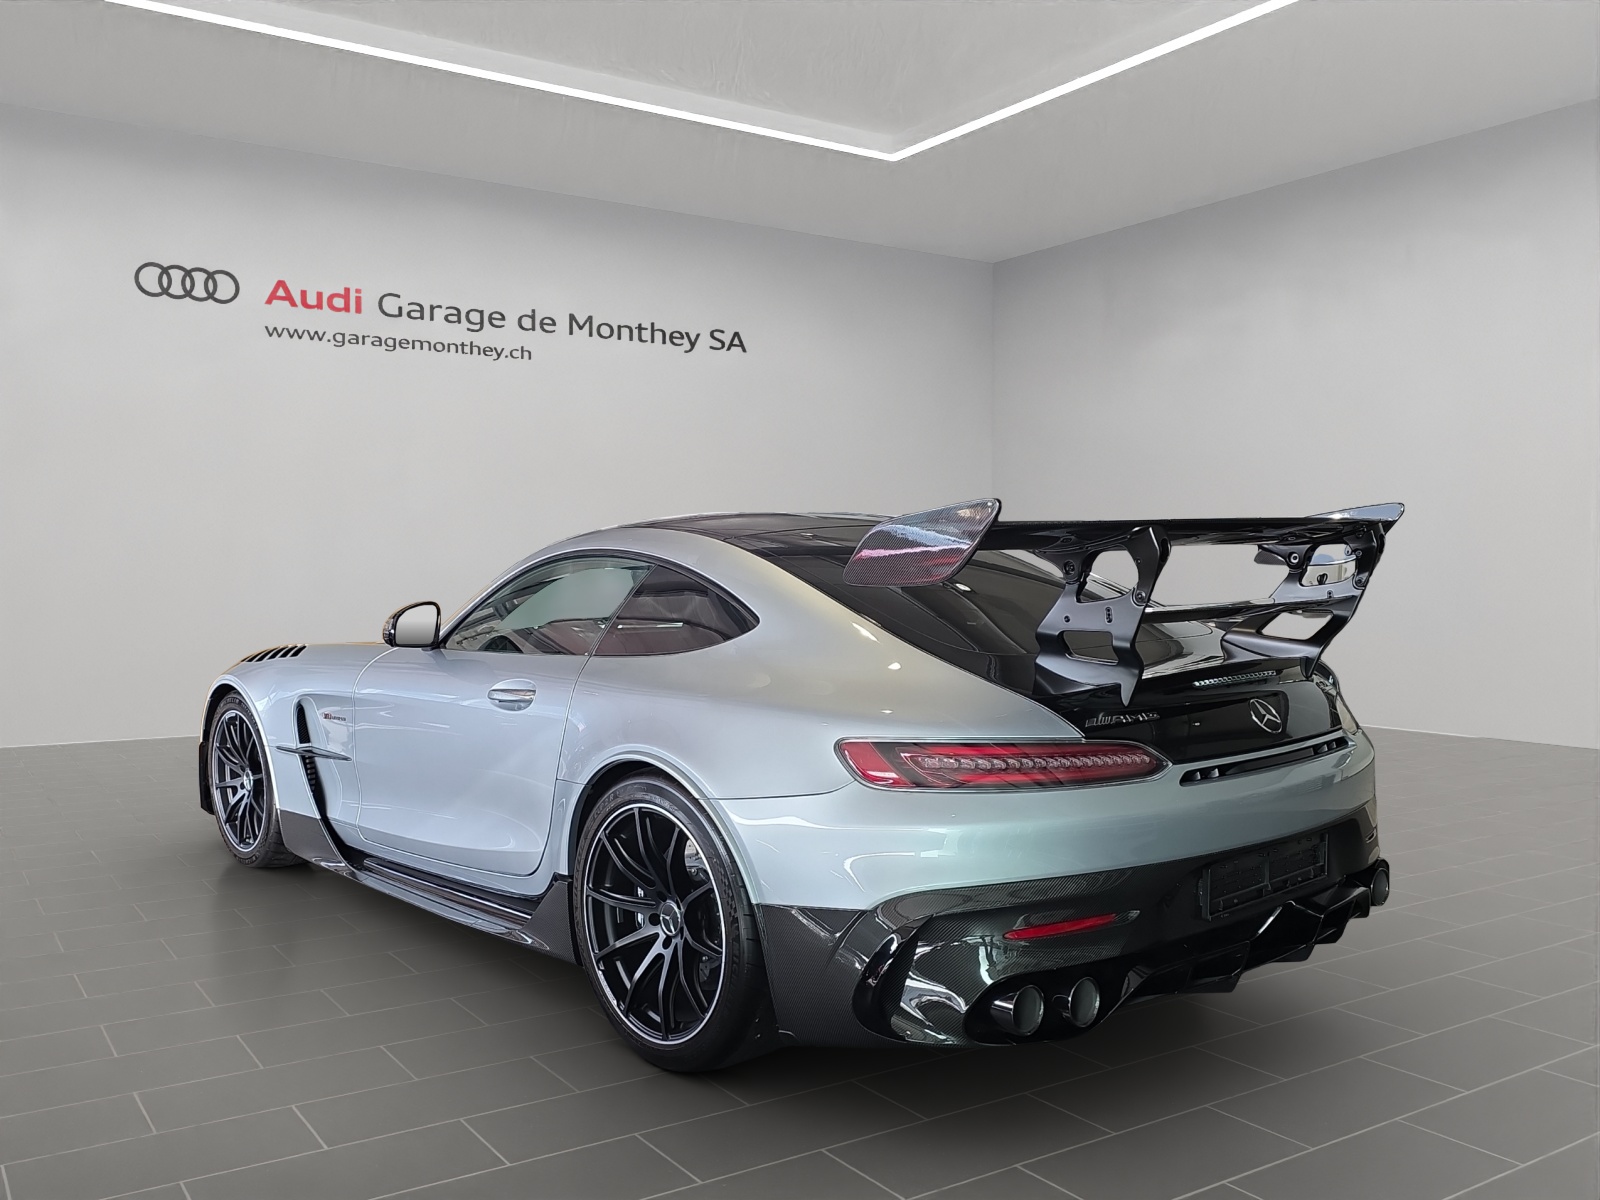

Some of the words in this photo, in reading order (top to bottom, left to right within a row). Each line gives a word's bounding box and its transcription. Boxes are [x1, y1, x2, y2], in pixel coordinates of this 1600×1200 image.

[264, 279, 363, 315] Audi
[377, 292, 506, 333] Garage
[517, 308, 557, 334] de
[568, 312, 701, 354] Monthey
[709, 328, 748, 354] SA
[264, 325, 533, 362] www.garagemonthey.ch
